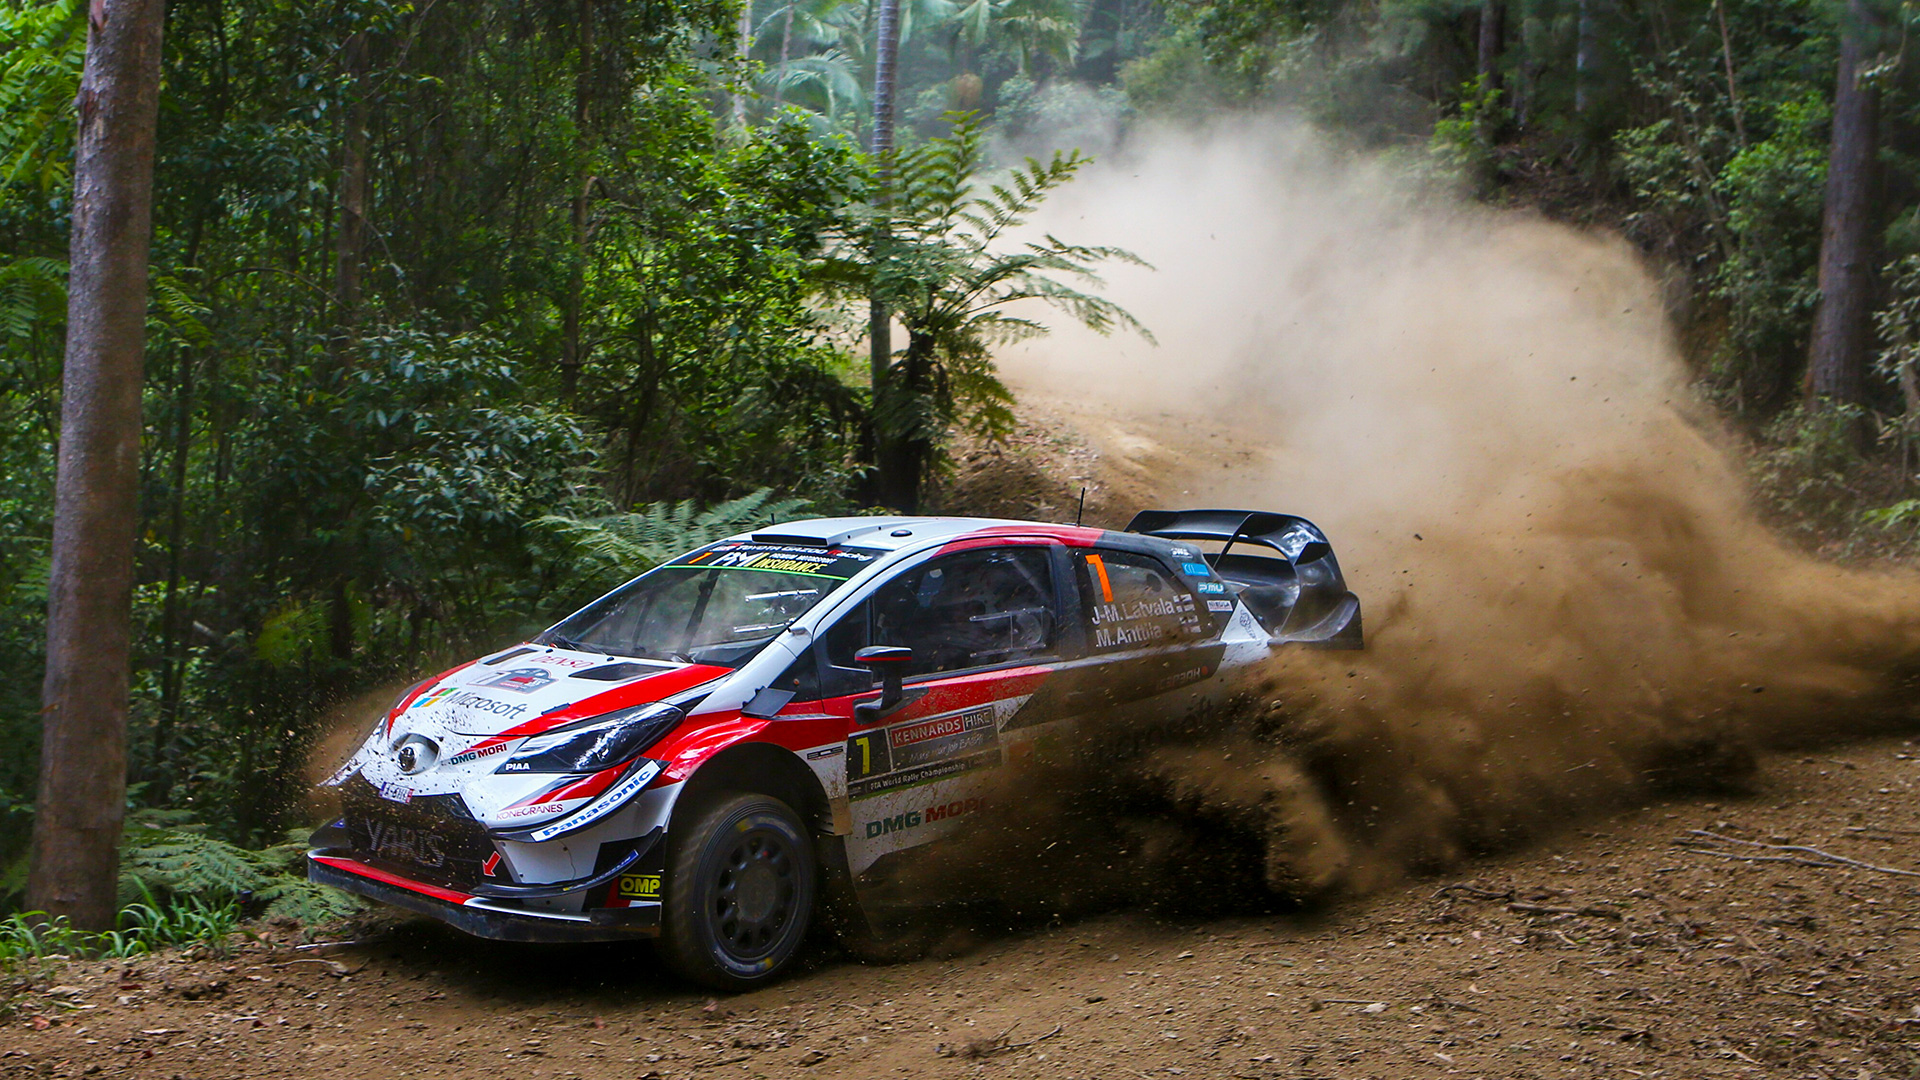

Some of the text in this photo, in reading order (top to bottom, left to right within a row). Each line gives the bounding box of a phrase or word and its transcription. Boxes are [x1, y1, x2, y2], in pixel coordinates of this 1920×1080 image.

[781, 546, 829, 555] GAZOO
[827, 549, 874, 562] Racing
[752, 558, 828, 574] INSURANCE
[530, 655, 595, 669] DENSO
[440, 690, 528, 720] Microsoft
[894, 718, 962, 745] KENNARDS
[451, 743, 508, 766] DMG MORI
[505, 762, 531, 771] PIAA
[870, 782, 882, 791] FIA
[881, 775, 902, 788] World
[902, 772, 921, 784] Rally
[920, 762, 966, 779] Championship
[496, 803, 564, 820] KONECRANES
[542, 770, 651, 837] Panasonic
[866, 810, 921, 840] DMG
[619, 879, 661, 894] OMP
